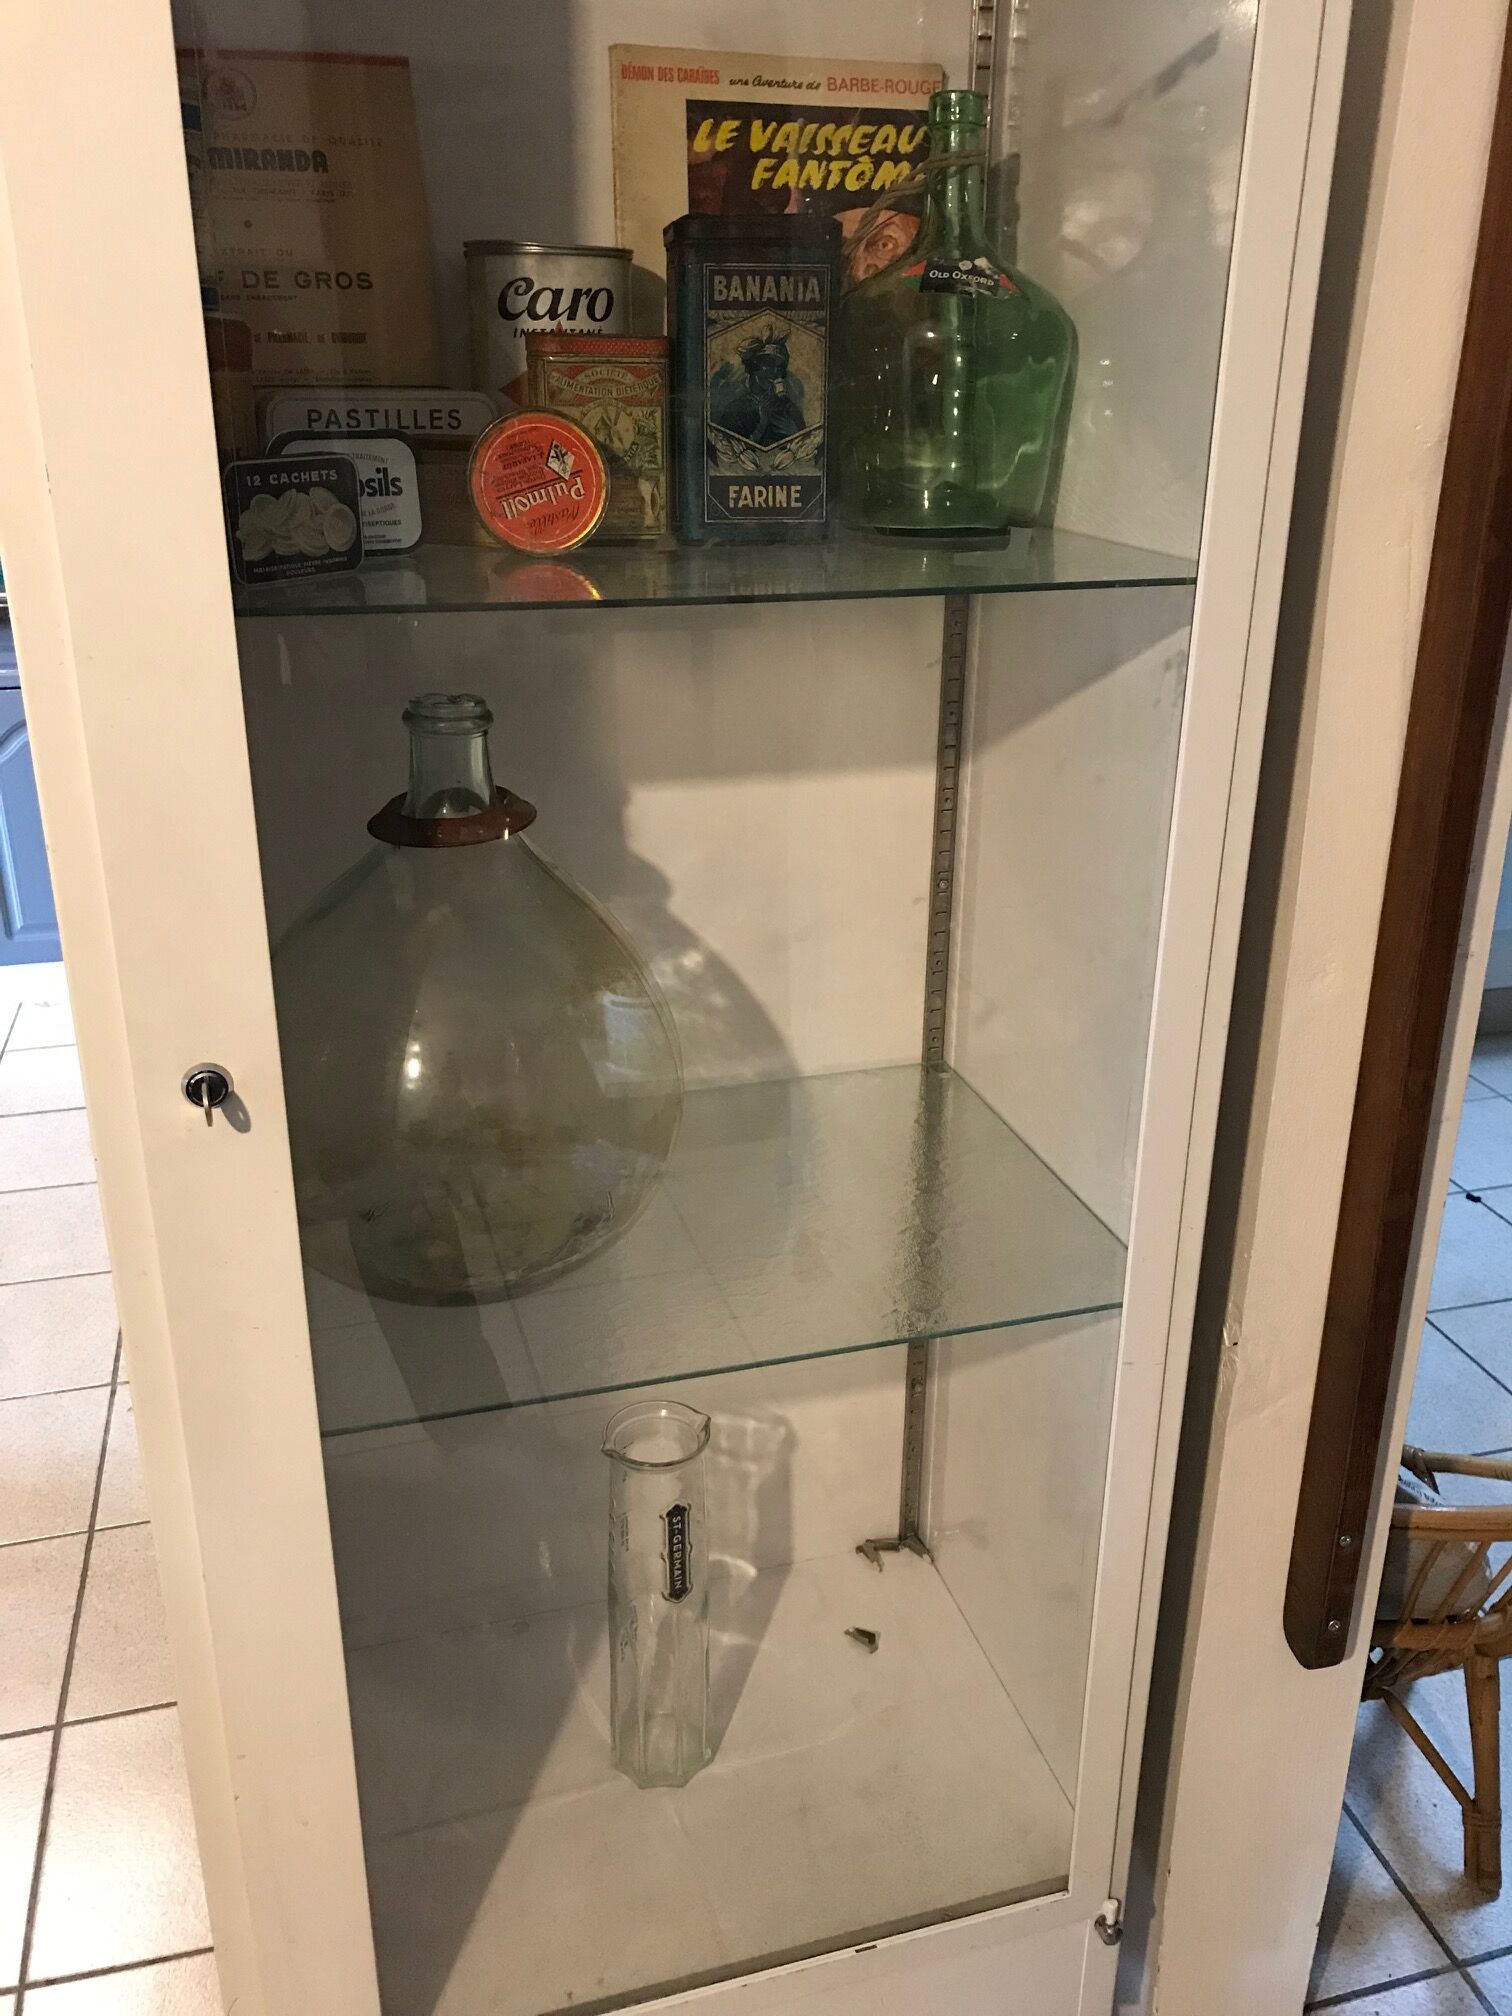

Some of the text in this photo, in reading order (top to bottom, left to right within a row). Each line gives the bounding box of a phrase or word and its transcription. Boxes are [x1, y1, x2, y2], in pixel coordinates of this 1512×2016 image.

[657, 66, 674, 82] DES
[729, 77, 749, 86] une
[805, 79, 822, 90] de
[826, 76, 941, 95] BARBE-ROUGE
[692, 118, 928, 155] LE VAISSEAU
[207, 147, 329, 173] MIRANDA
[241, 270, 280, 289] DE
[294, 271, 374, 290] GROS
[929, 269, 950, 279] OLD
[497, 277, 615, 323] Caro
[713, 274, 821, 303] BANANIA
[306, 408, 463, 431] PASTILLES
[246, 469, 339, 487] 12 CACHETS
[501, 477, 586, 520] Pulmoll
[728, 485, 803, 509] FARINE
[362, 519, 402, 527] TISEPTIQUES
[671, 1515, 682, 1590] ST-GERMAIN
